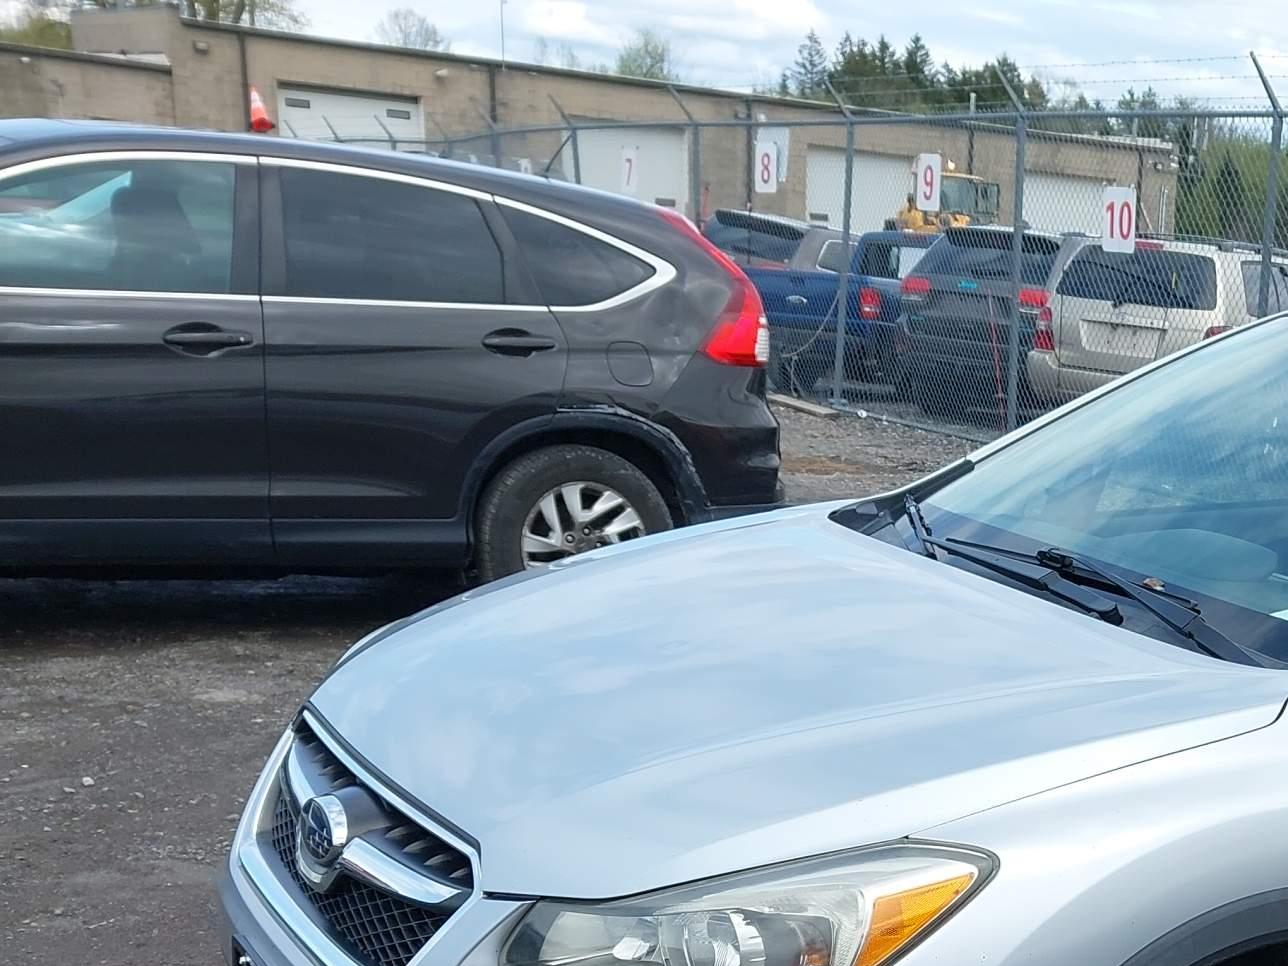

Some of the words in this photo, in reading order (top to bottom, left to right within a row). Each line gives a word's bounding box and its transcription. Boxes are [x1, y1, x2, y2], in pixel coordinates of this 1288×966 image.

[625, 158, 633, 185] 7
[761, 153, 770, 184] 8
[923, 165, 934, 200] 9
[1105, 201, 1132, 240] 10
